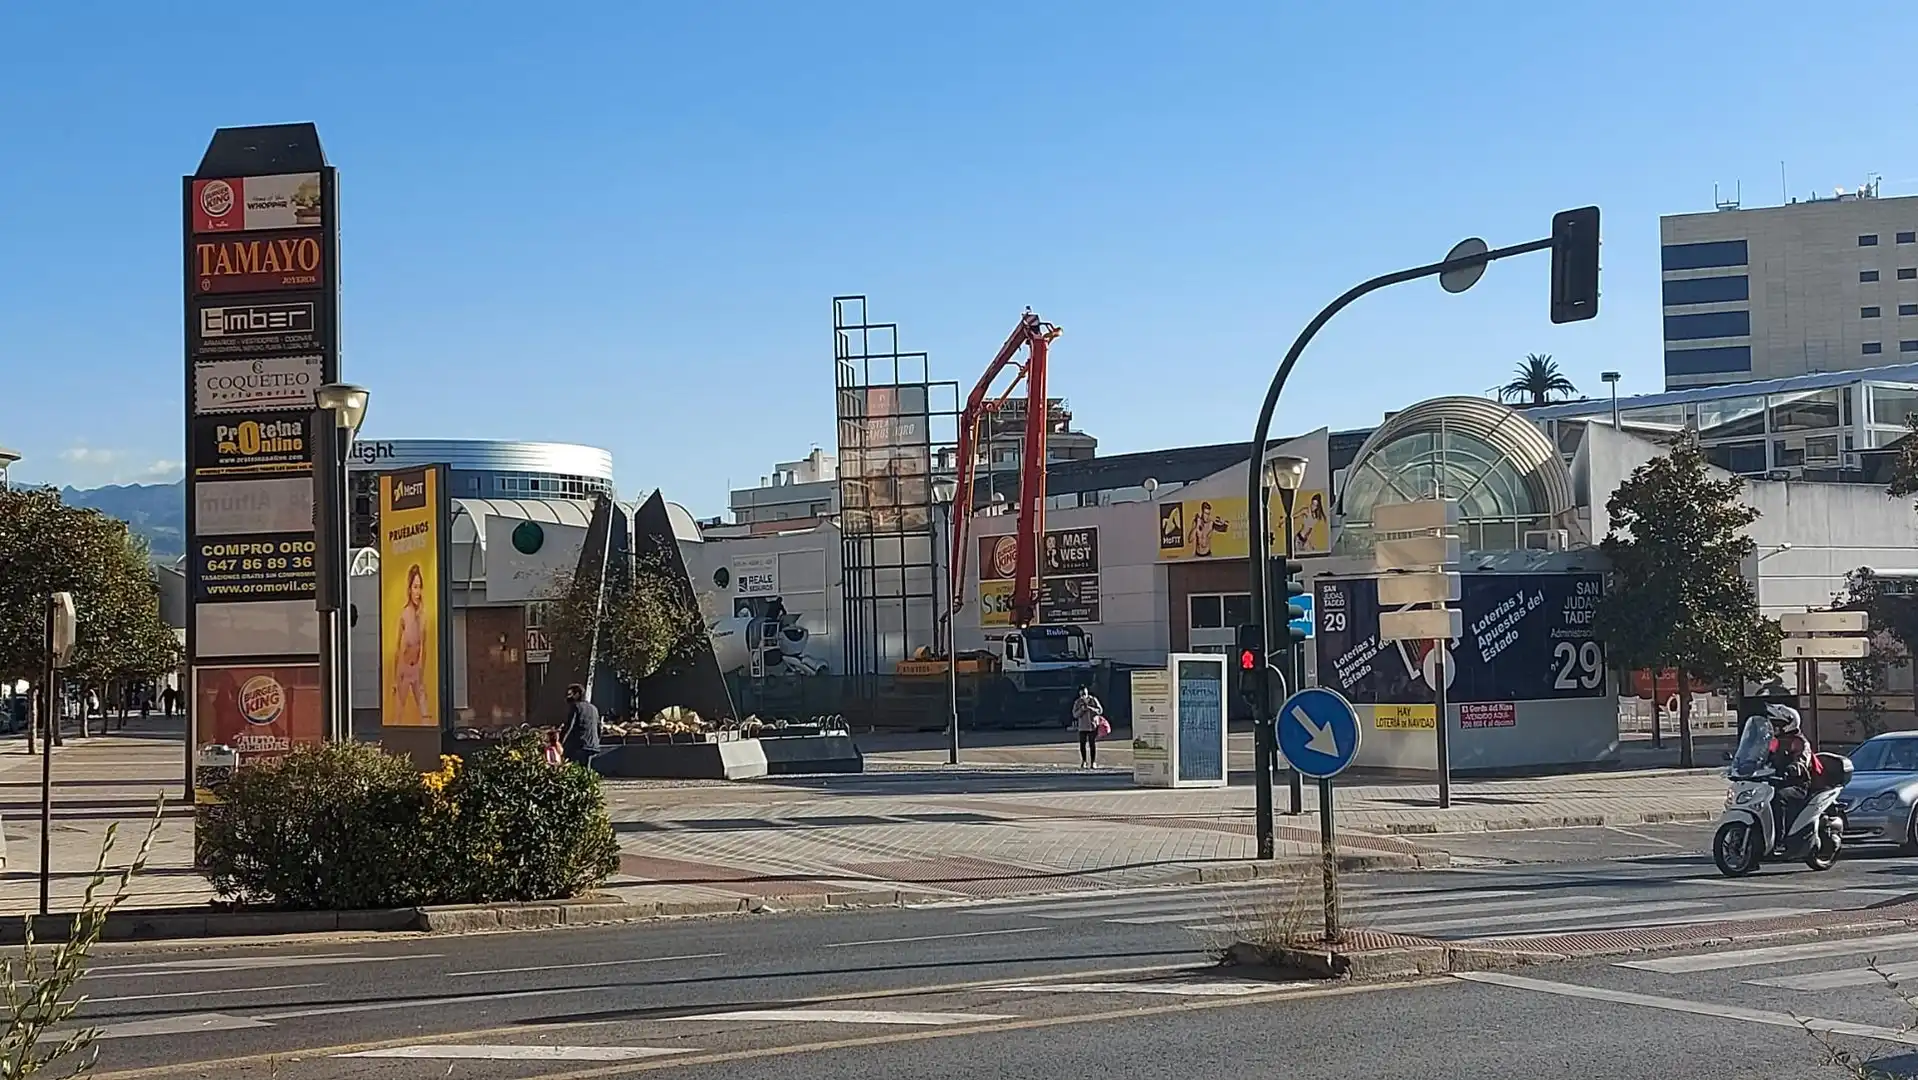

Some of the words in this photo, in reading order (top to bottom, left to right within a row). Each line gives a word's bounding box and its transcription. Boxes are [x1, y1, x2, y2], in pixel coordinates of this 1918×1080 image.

[206, 193, 230, 208] KING
[247, 201, 288, 210] WHOPPER
[197, 238, 320, 276] TAMAYO
[282, 276, 316, 284] JOYEROS
[204, 309, 306, 332] timber
[207, 372, 310, 391] COQUETEO
[1063, 533, 1088, 546] MAE
[201, 543, 275, 556] COMPRO
[279, 542, 316, 553] ORO
[1060, 548, 1091, 561] WEST
[207, 559, 238, 571] 647
[242, 558, 262, 570] 86
[267, 557, 287, 569] 89
[292, 556, 313, 568] 36
[749, 574, 773, 584] REALE
[206, 580, 317, 594] www.oromovil.es
[1576, 582, 1599, 595] SAN
[1325, 613, 1346, 631] 29
[1478, 607, 1526, 650] Apuestas
[1527, 589, 1545, 610] del
[1481, 630, 1519, 663] Estado
[1339, 646, 1377, 679] Apuestas
[1554, 641, 1602, 689] 29
[1342, 665, 1372, 689] Estado
[244, 684, 279, 702] BURGER
[246, 692, 280, 714] KING
[1397, 706, 1412, 717] HAY
[1408, 717, 1435, 728] NAVIDAD
[241, 735, 276, 745] AUTO
